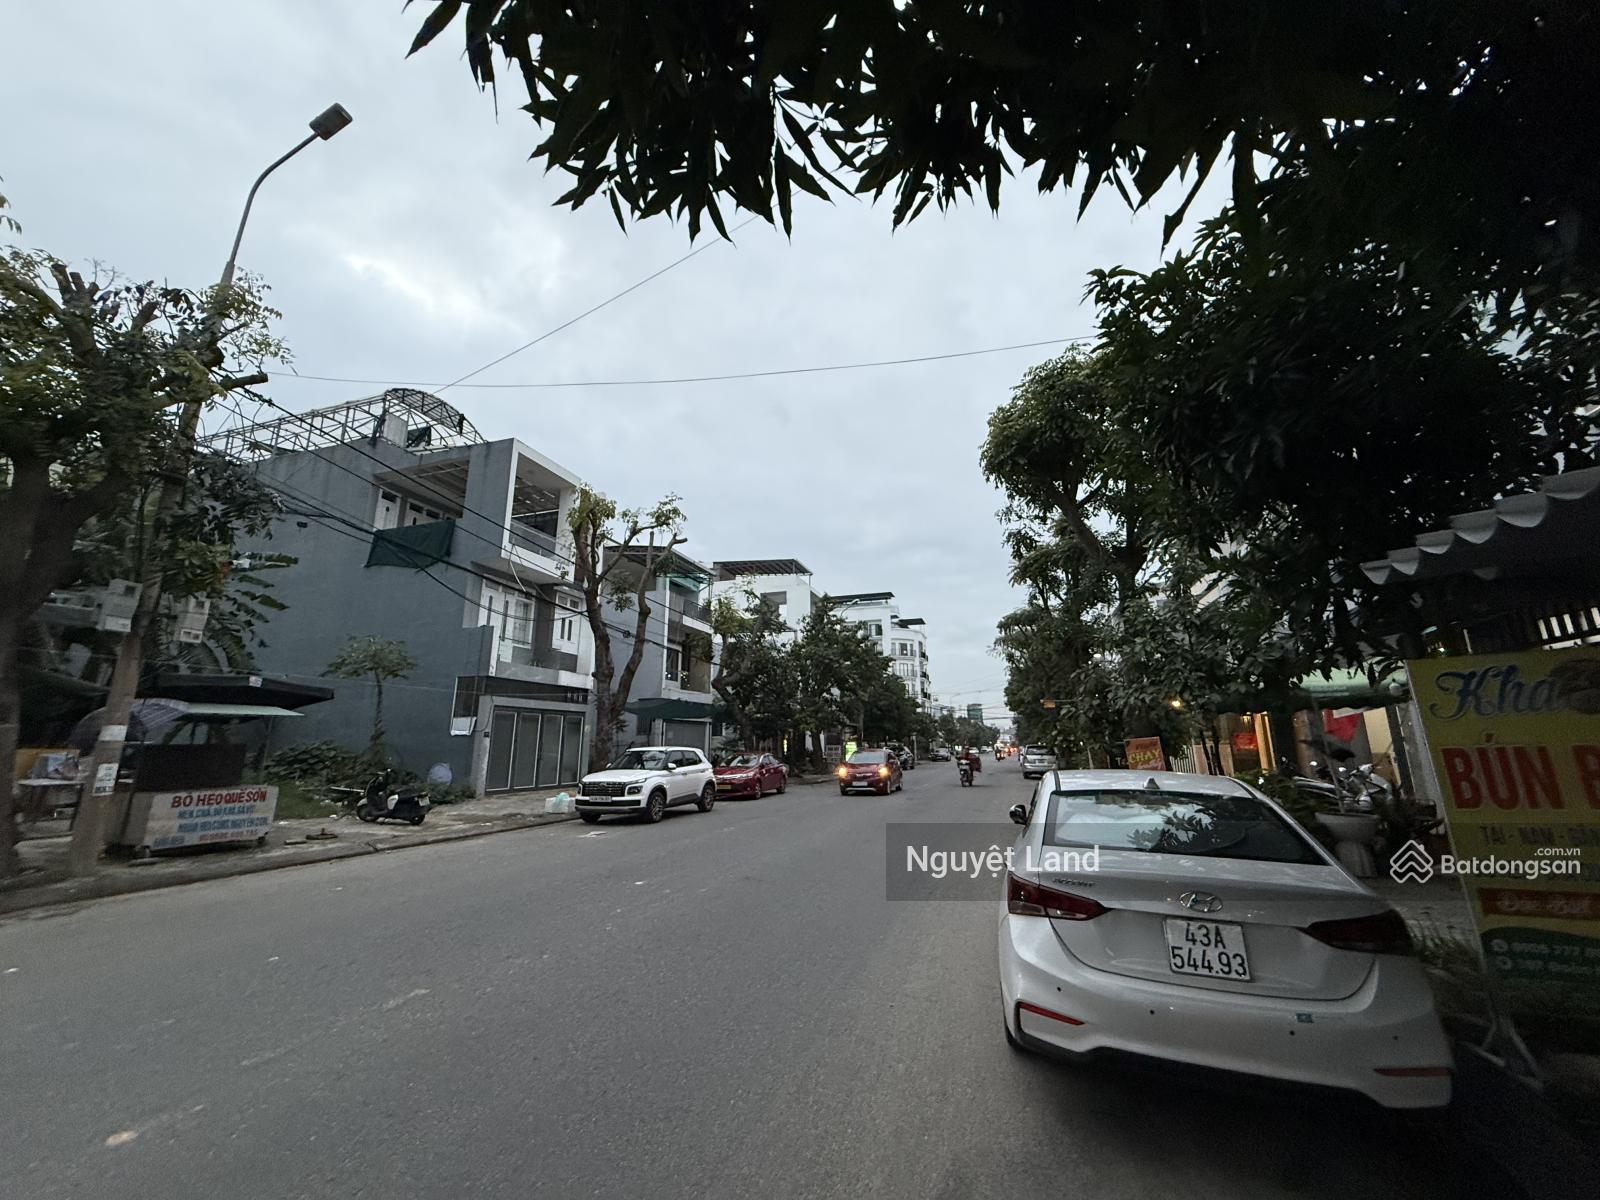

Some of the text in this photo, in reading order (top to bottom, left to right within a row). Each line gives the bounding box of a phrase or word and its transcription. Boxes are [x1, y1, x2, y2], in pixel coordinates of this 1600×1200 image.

[1440, 733, 1565, 809] BÚN
[196, 793, 223, 806] HEO
[1185, 922, 1226, 949] 43A
[1171, 946, 1248, 976] 544.93
